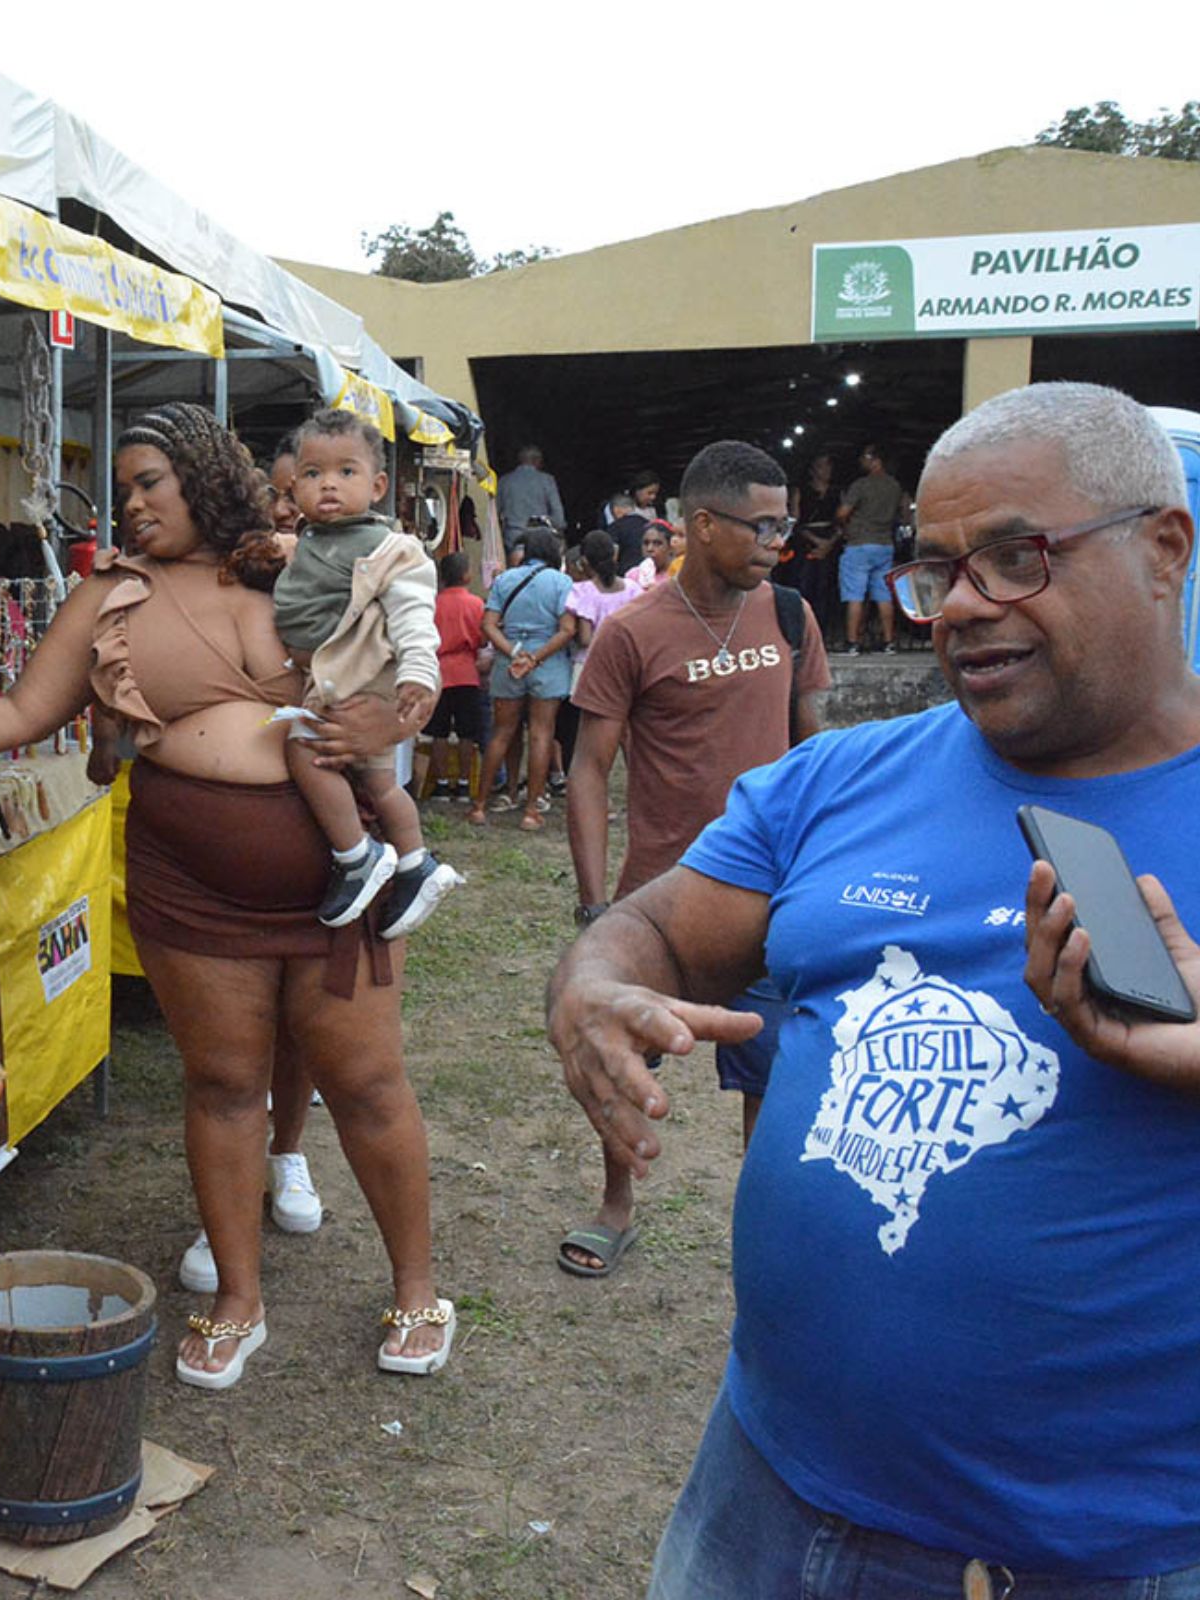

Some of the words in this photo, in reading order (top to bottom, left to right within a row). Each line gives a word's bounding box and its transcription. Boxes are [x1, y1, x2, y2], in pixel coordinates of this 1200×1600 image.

[970, 237, 1140, 275] PAVILHÃO
[918, 294, 1050, 317] ARMANDO
[1054, 295, 1077, 313] R.
[1082, 287, 1192, 310] MORAES
[865, 1028, 988, 1073] ECOSOL
[843, 1074, 986, 1137] FORTE
[830, 1127, 943, 1183] NORDESTE
